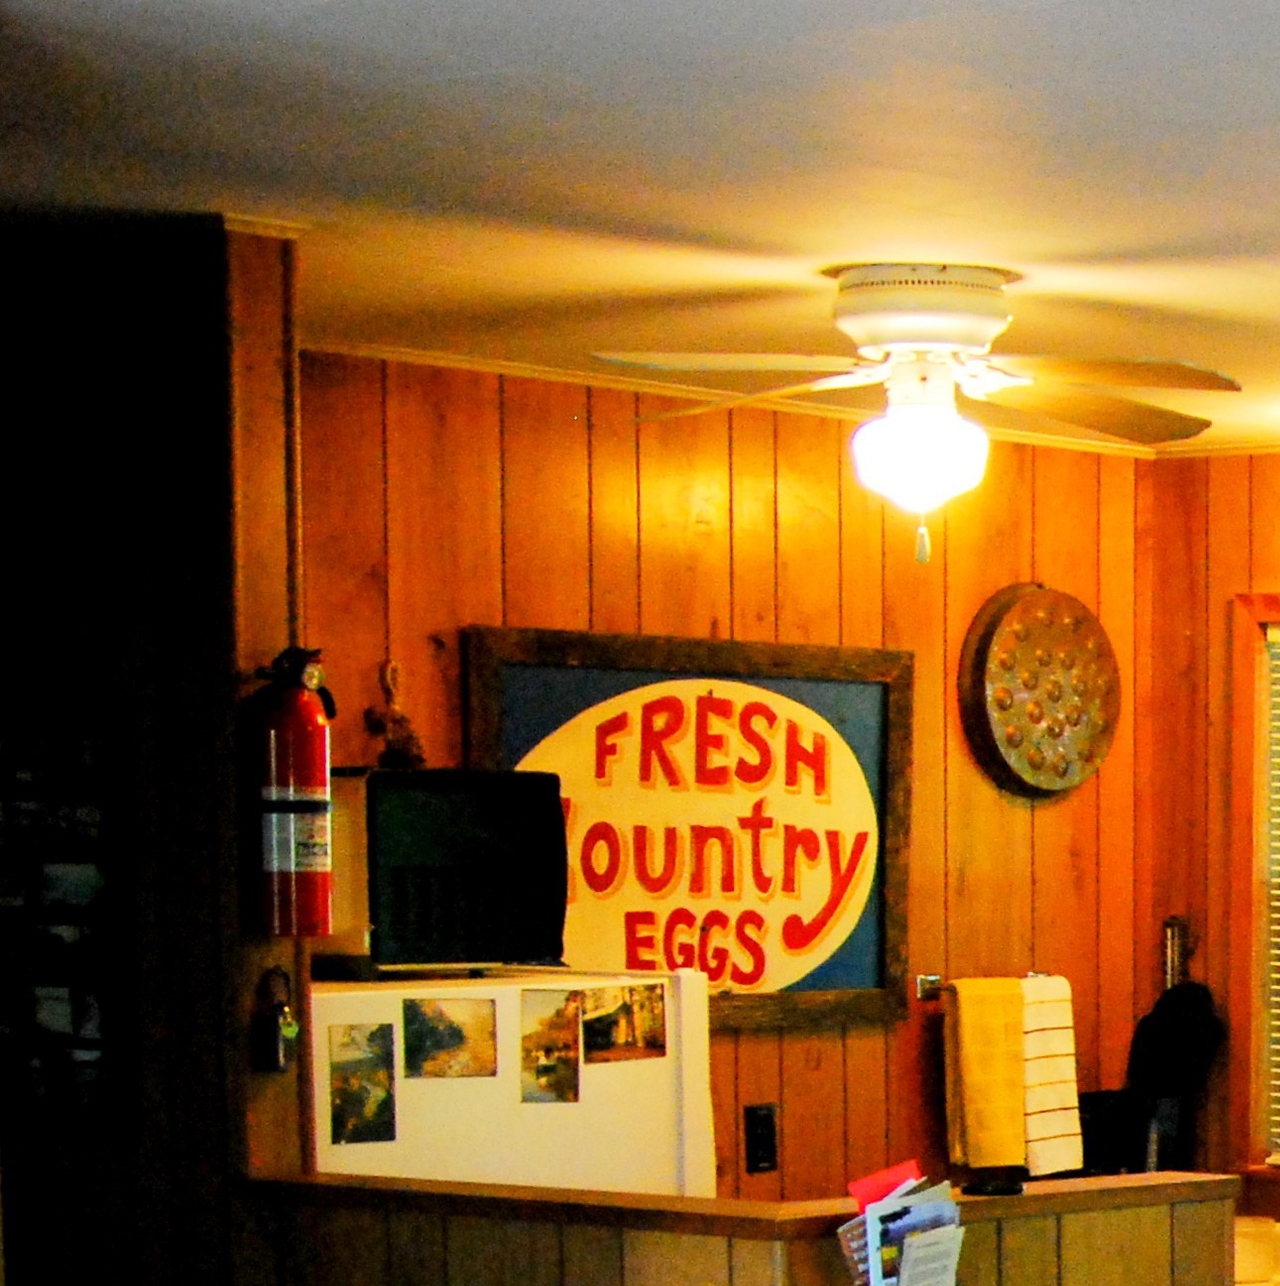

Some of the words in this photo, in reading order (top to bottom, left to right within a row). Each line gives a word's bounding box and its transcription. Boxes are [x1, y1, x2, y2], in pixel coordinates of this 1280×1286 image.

[594, 694, 828, 798] FRESH
[562, 796, 870, 951] ountry
[625, 907, 767, 986] EGGS
